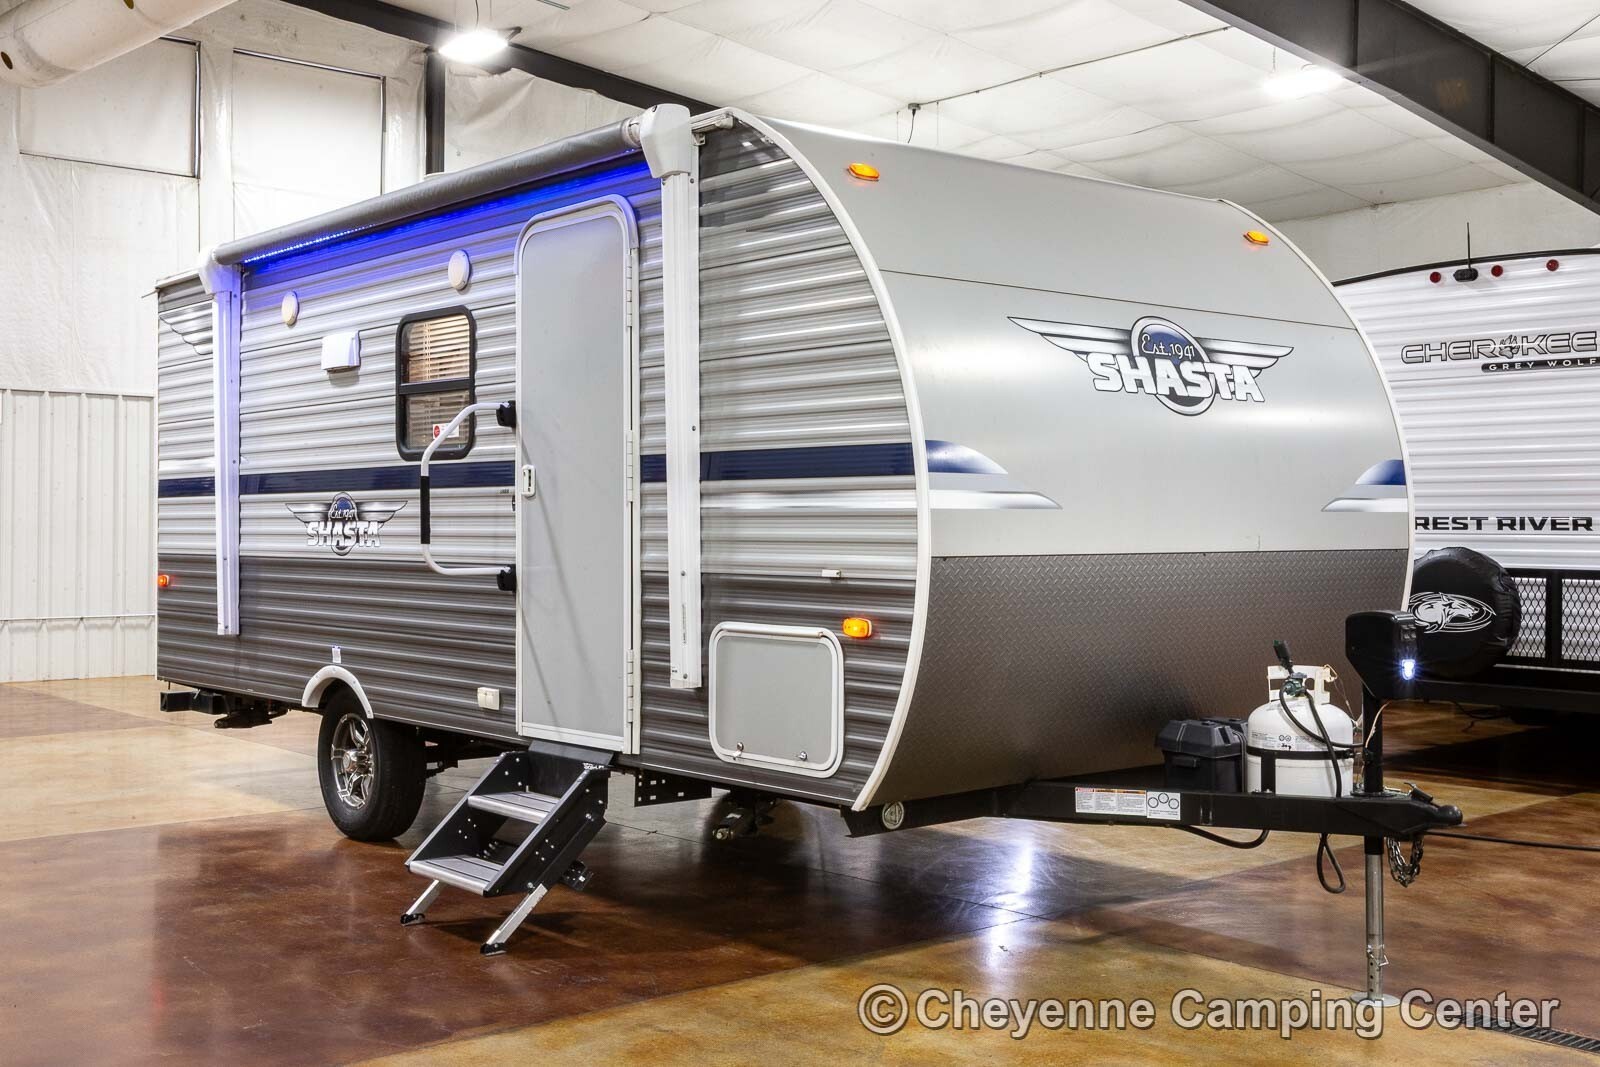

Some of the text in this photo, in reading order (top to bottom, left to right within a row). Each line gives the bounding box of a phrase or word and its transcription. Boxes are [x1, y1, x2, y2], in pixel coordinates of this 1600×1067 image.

[1401, 330, 1597, 364] CHERKEE
[1087, 352, 1265, 402] SHASTA
[1488, 358, 1598, 371] GREY WOLF
[306, 521, 381, 547] SHASTA
[1496, 516, 1594, 531] RIVER
